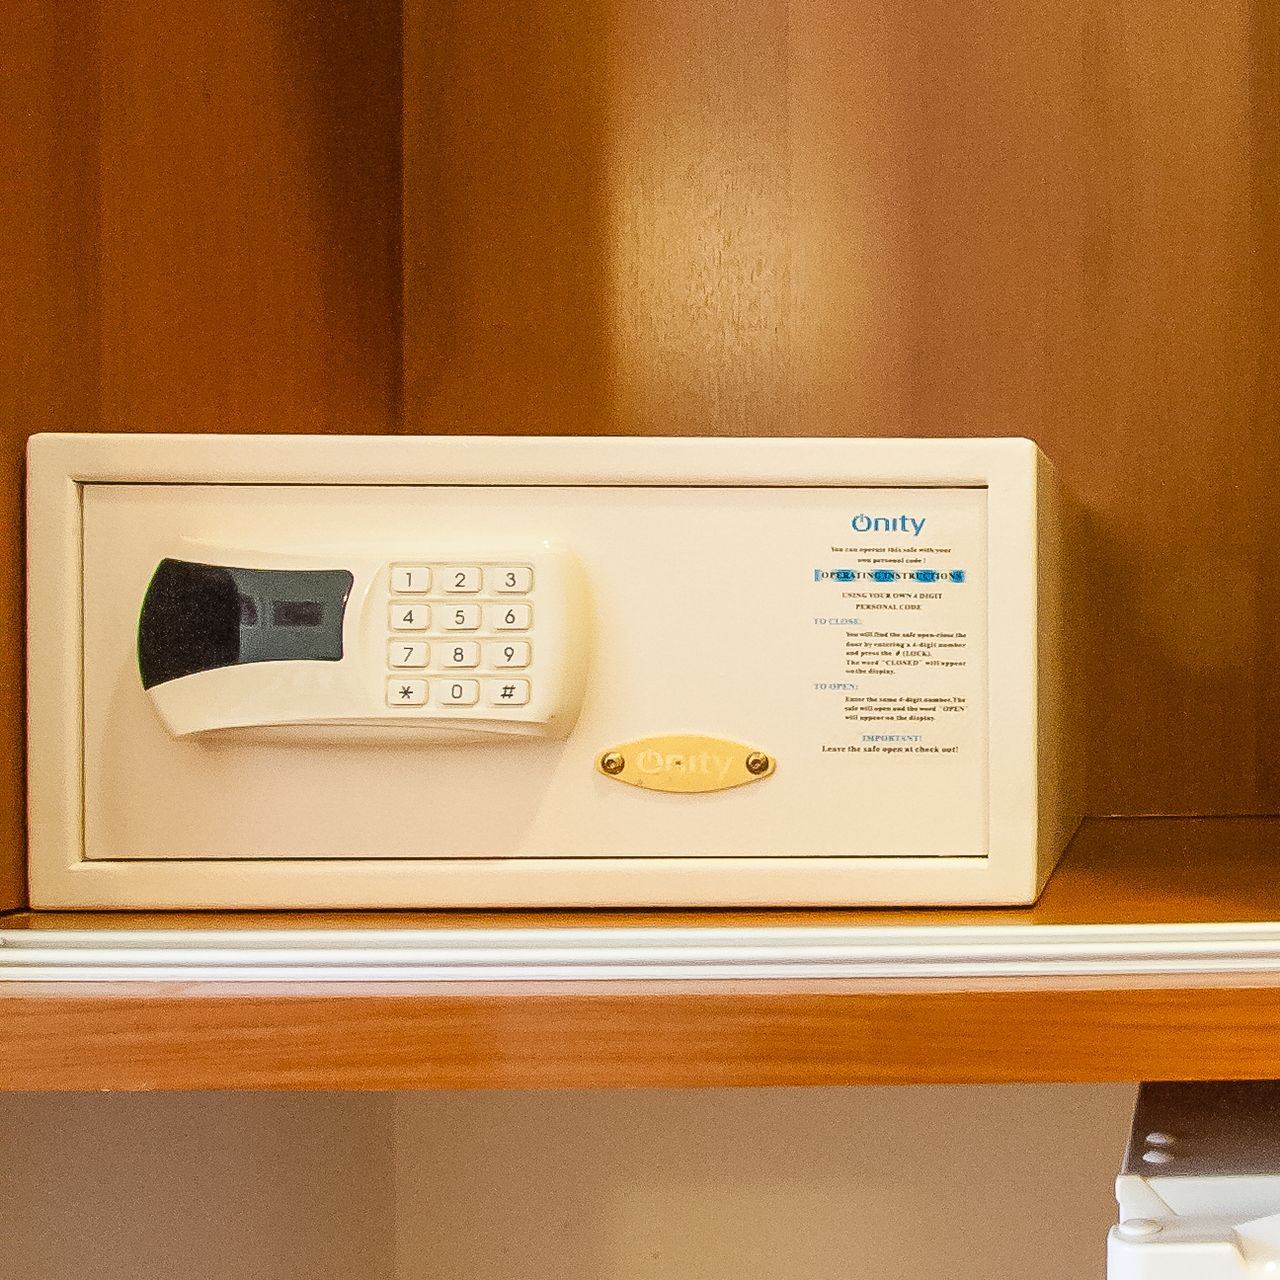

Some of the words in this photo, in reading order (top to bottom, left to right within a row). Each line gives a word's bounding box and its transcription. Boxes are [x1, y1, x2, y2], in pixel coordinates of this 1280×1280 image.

[851, 513, 926, 537] Onity
[406, 572, 412, 587] 1
[454, 572, 466, 588] 2
[505, 572, 516, 588] 3
[821, 571, 883, 580] OPERATING
[884, 571, 962, 580] INSTRUCTIONS
[402, 609, 414, 624] 4
[454, 609, 465, 625] 5
[505, 609, 515, 624] 6
[403, 647, 414, 663] 7
[452, 647, 464, 662] 8
[503, 646, 515, 662] 9
[500, 684, 516, 699] #
[822, 745, 846, 753] Leave
[848, 745, 862, 753] the
[863, 745, 881, 753] safe
[637, 748, 734, 782] Onity
